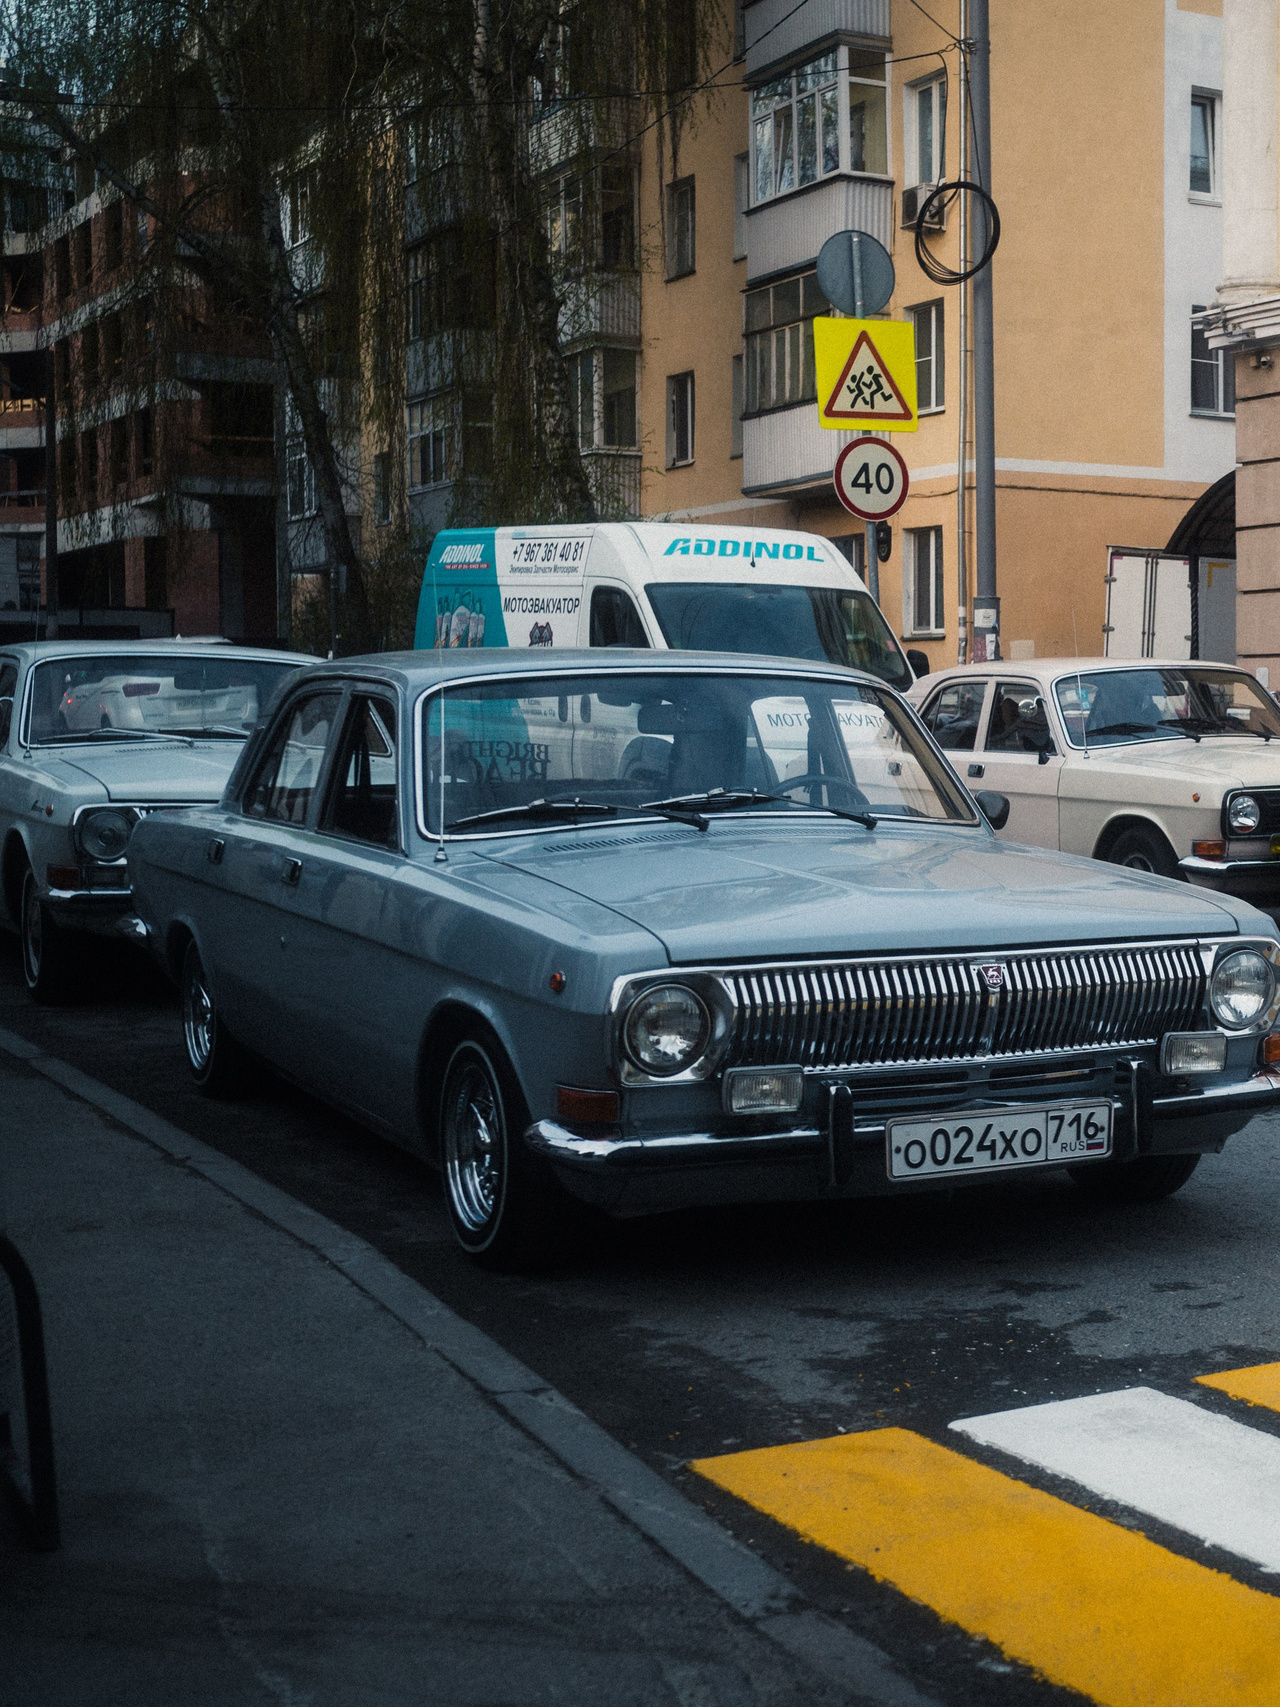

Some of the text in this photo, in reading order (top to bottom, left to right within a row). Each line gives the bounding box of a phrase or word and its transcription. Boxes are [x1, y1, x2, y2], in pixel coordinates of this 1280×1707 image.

[851, 462, 895, 495] 40
[439, 544, 485, 563] ADDINOL
[513, 541, 584, 562] +7 967 361 40 81
[663, 538, 824, 562] ADDINOL
[503, 597, 580, 614] МОТОЭВАКУАТОР
[904, 1112, 1099, 1169] О024ХО 716 RUS
